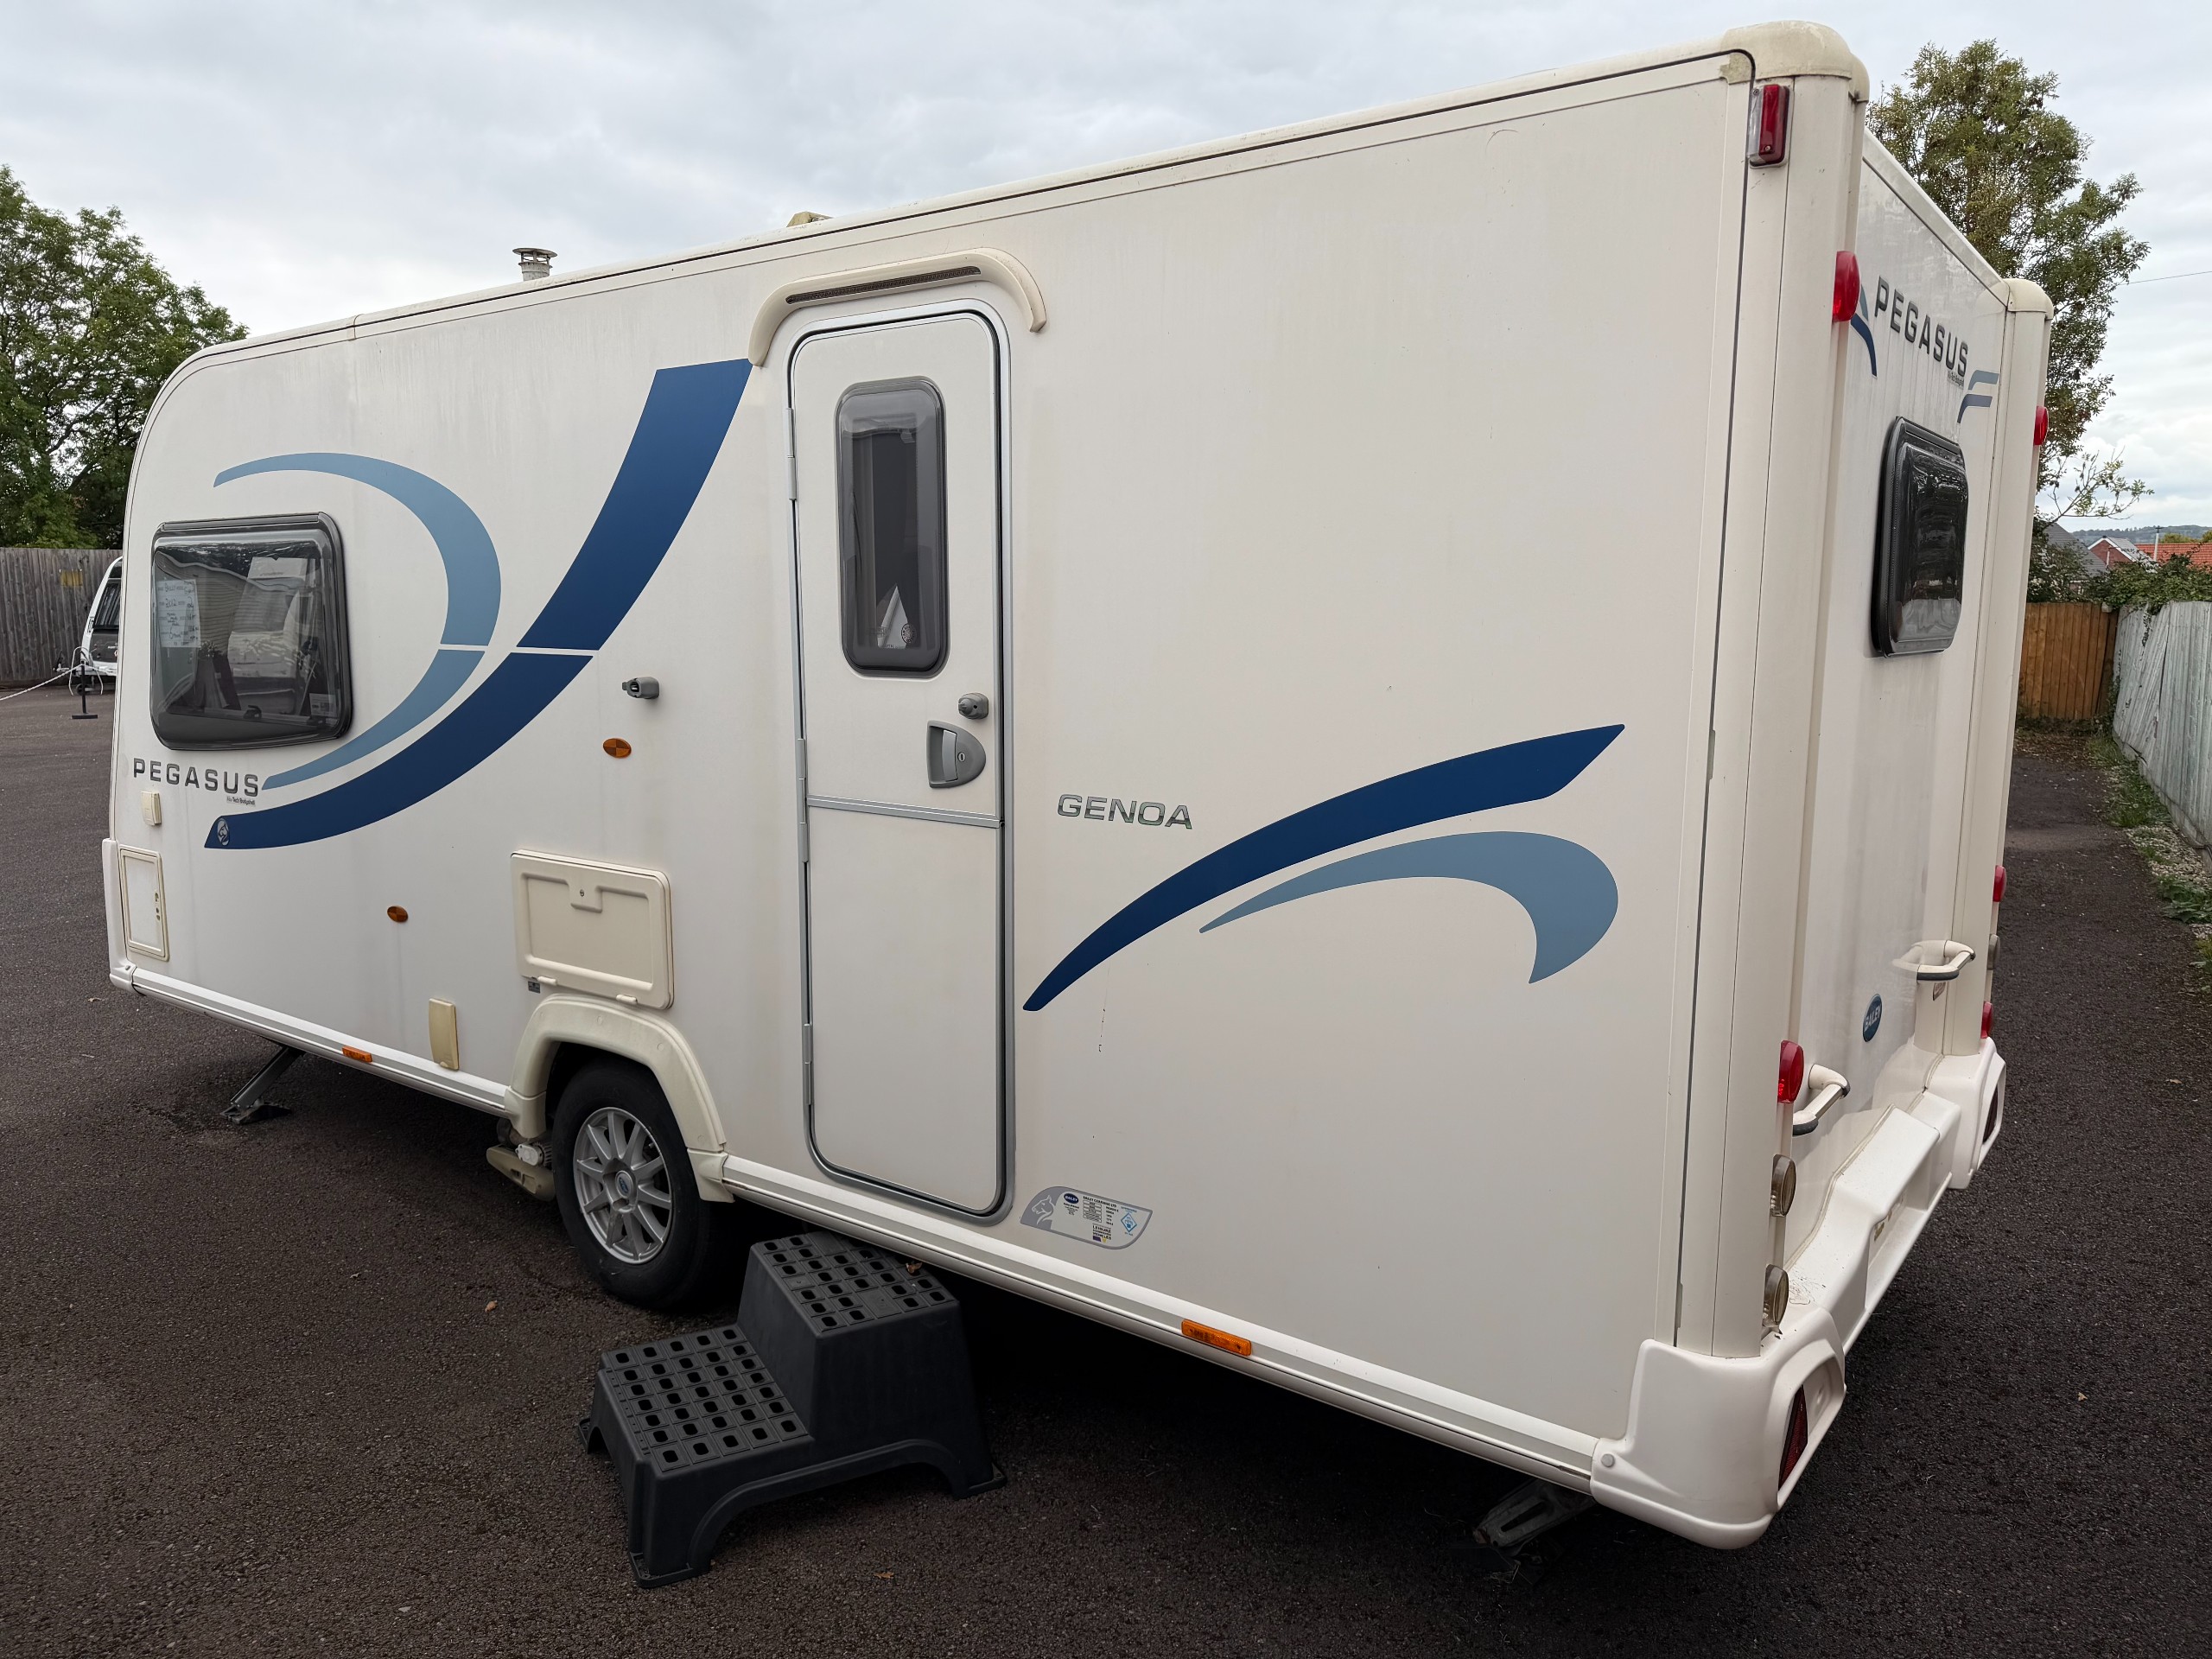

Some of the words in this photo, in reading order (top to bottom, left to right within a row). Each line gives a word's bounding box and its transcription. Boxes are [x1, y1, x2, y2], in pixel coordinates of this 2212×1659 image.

[1874, 275, 1968, 378] PEGASUS
[133, 757, 258, 798] PEGASUS
[1057, 793, 1192, 830] GENOA
